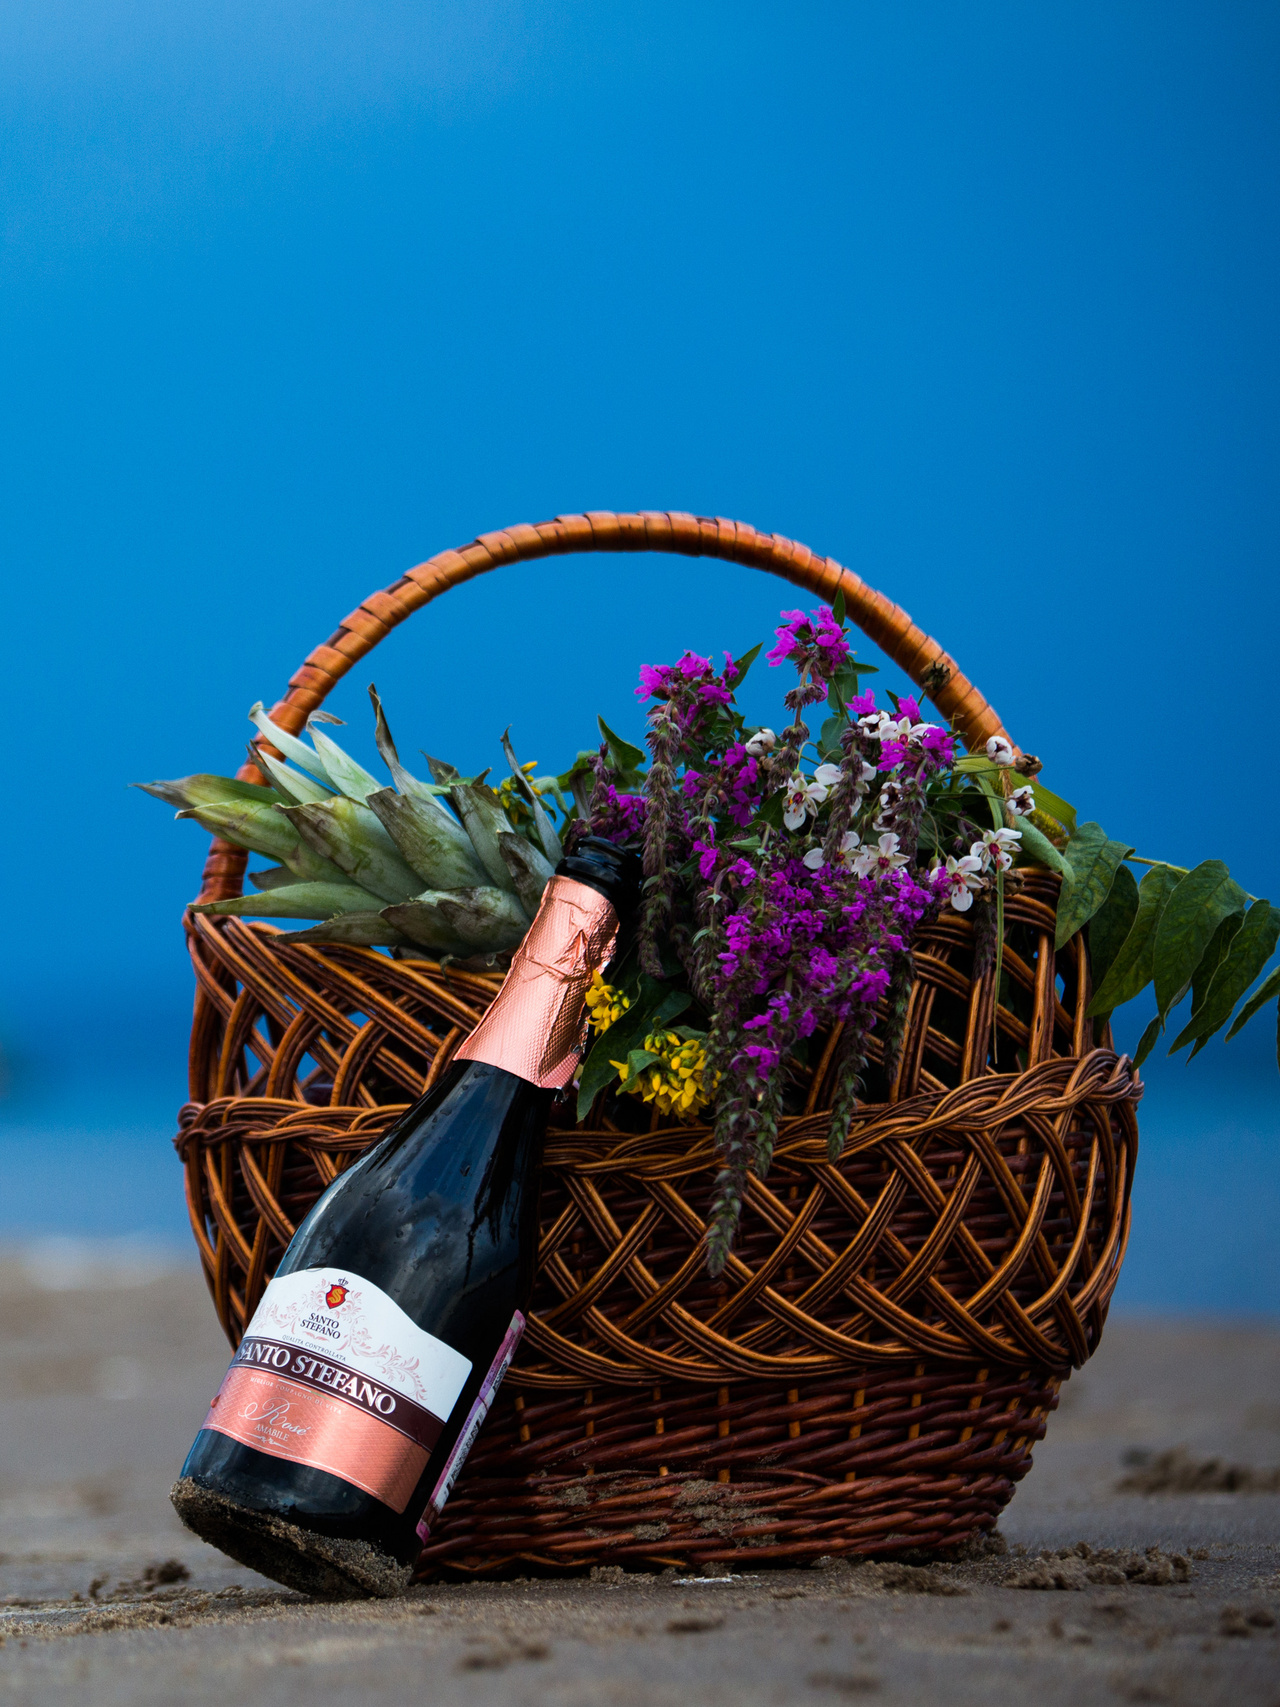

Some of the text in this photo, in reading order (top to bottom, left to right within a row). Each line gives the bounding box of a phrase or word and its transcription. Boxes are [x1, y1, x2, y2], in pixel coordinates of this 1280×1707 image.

[300, 1319, 341, 1339] STEFANO
[309, 1313, 340, 1328] SANTO
[305, 1341, 346, 1361] CONTROLLATA
[237, 1342, 397, 1415] SANTO STEFANO
[276, 1384, 312, 1400] COMPAGNO
[326, 1404, 342, 1415] VITA
[238, 1397, 312, 1436] Rosé
[254, 1424, 290, 1442] AMABILE
